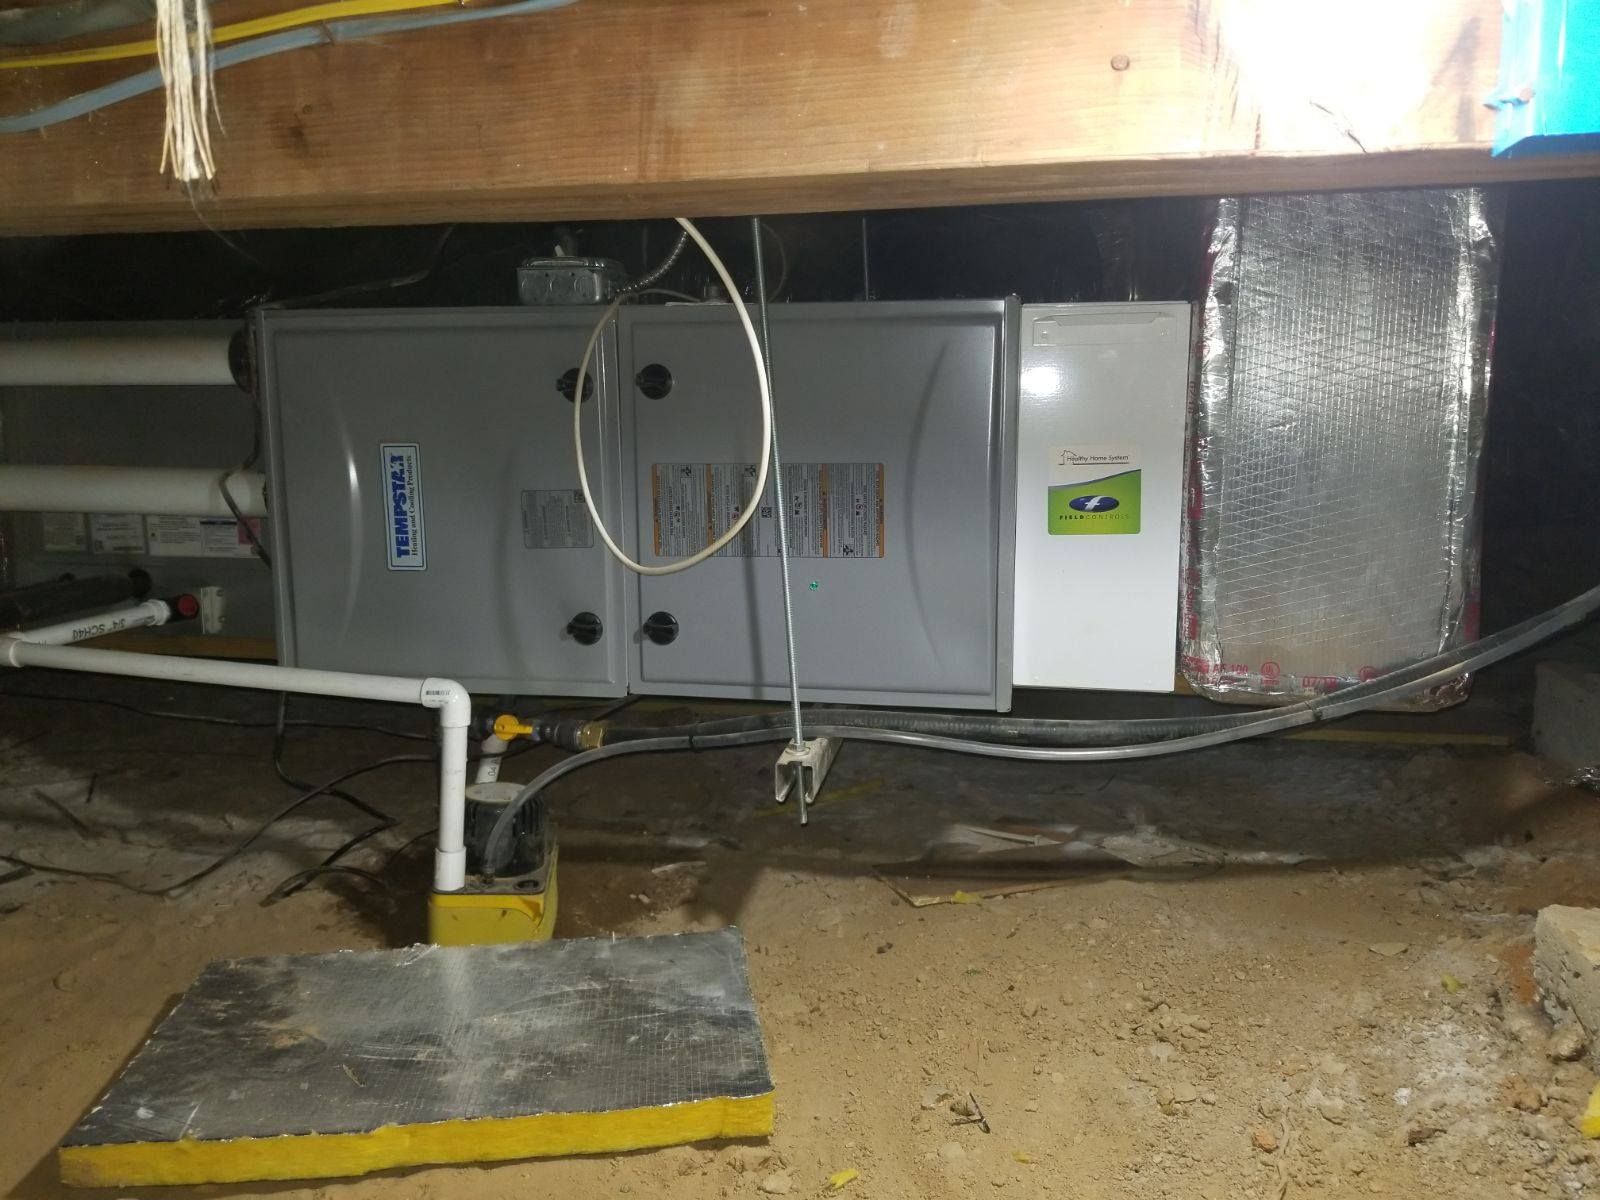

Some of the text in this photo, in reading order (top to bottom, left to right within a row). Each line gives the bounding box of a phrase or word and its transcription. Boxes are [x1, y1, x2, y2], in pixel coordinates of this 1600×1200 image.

[406, 455, 415, 486] Products
[1067, 455, 1088, 463] Healthy
[390, 455, 410, 558] TEMPSTAR
[408, 486, 416, 514] Cooling
[410, 528, 419, 556] Heating
[72, 624, 106, 640] SCH40
